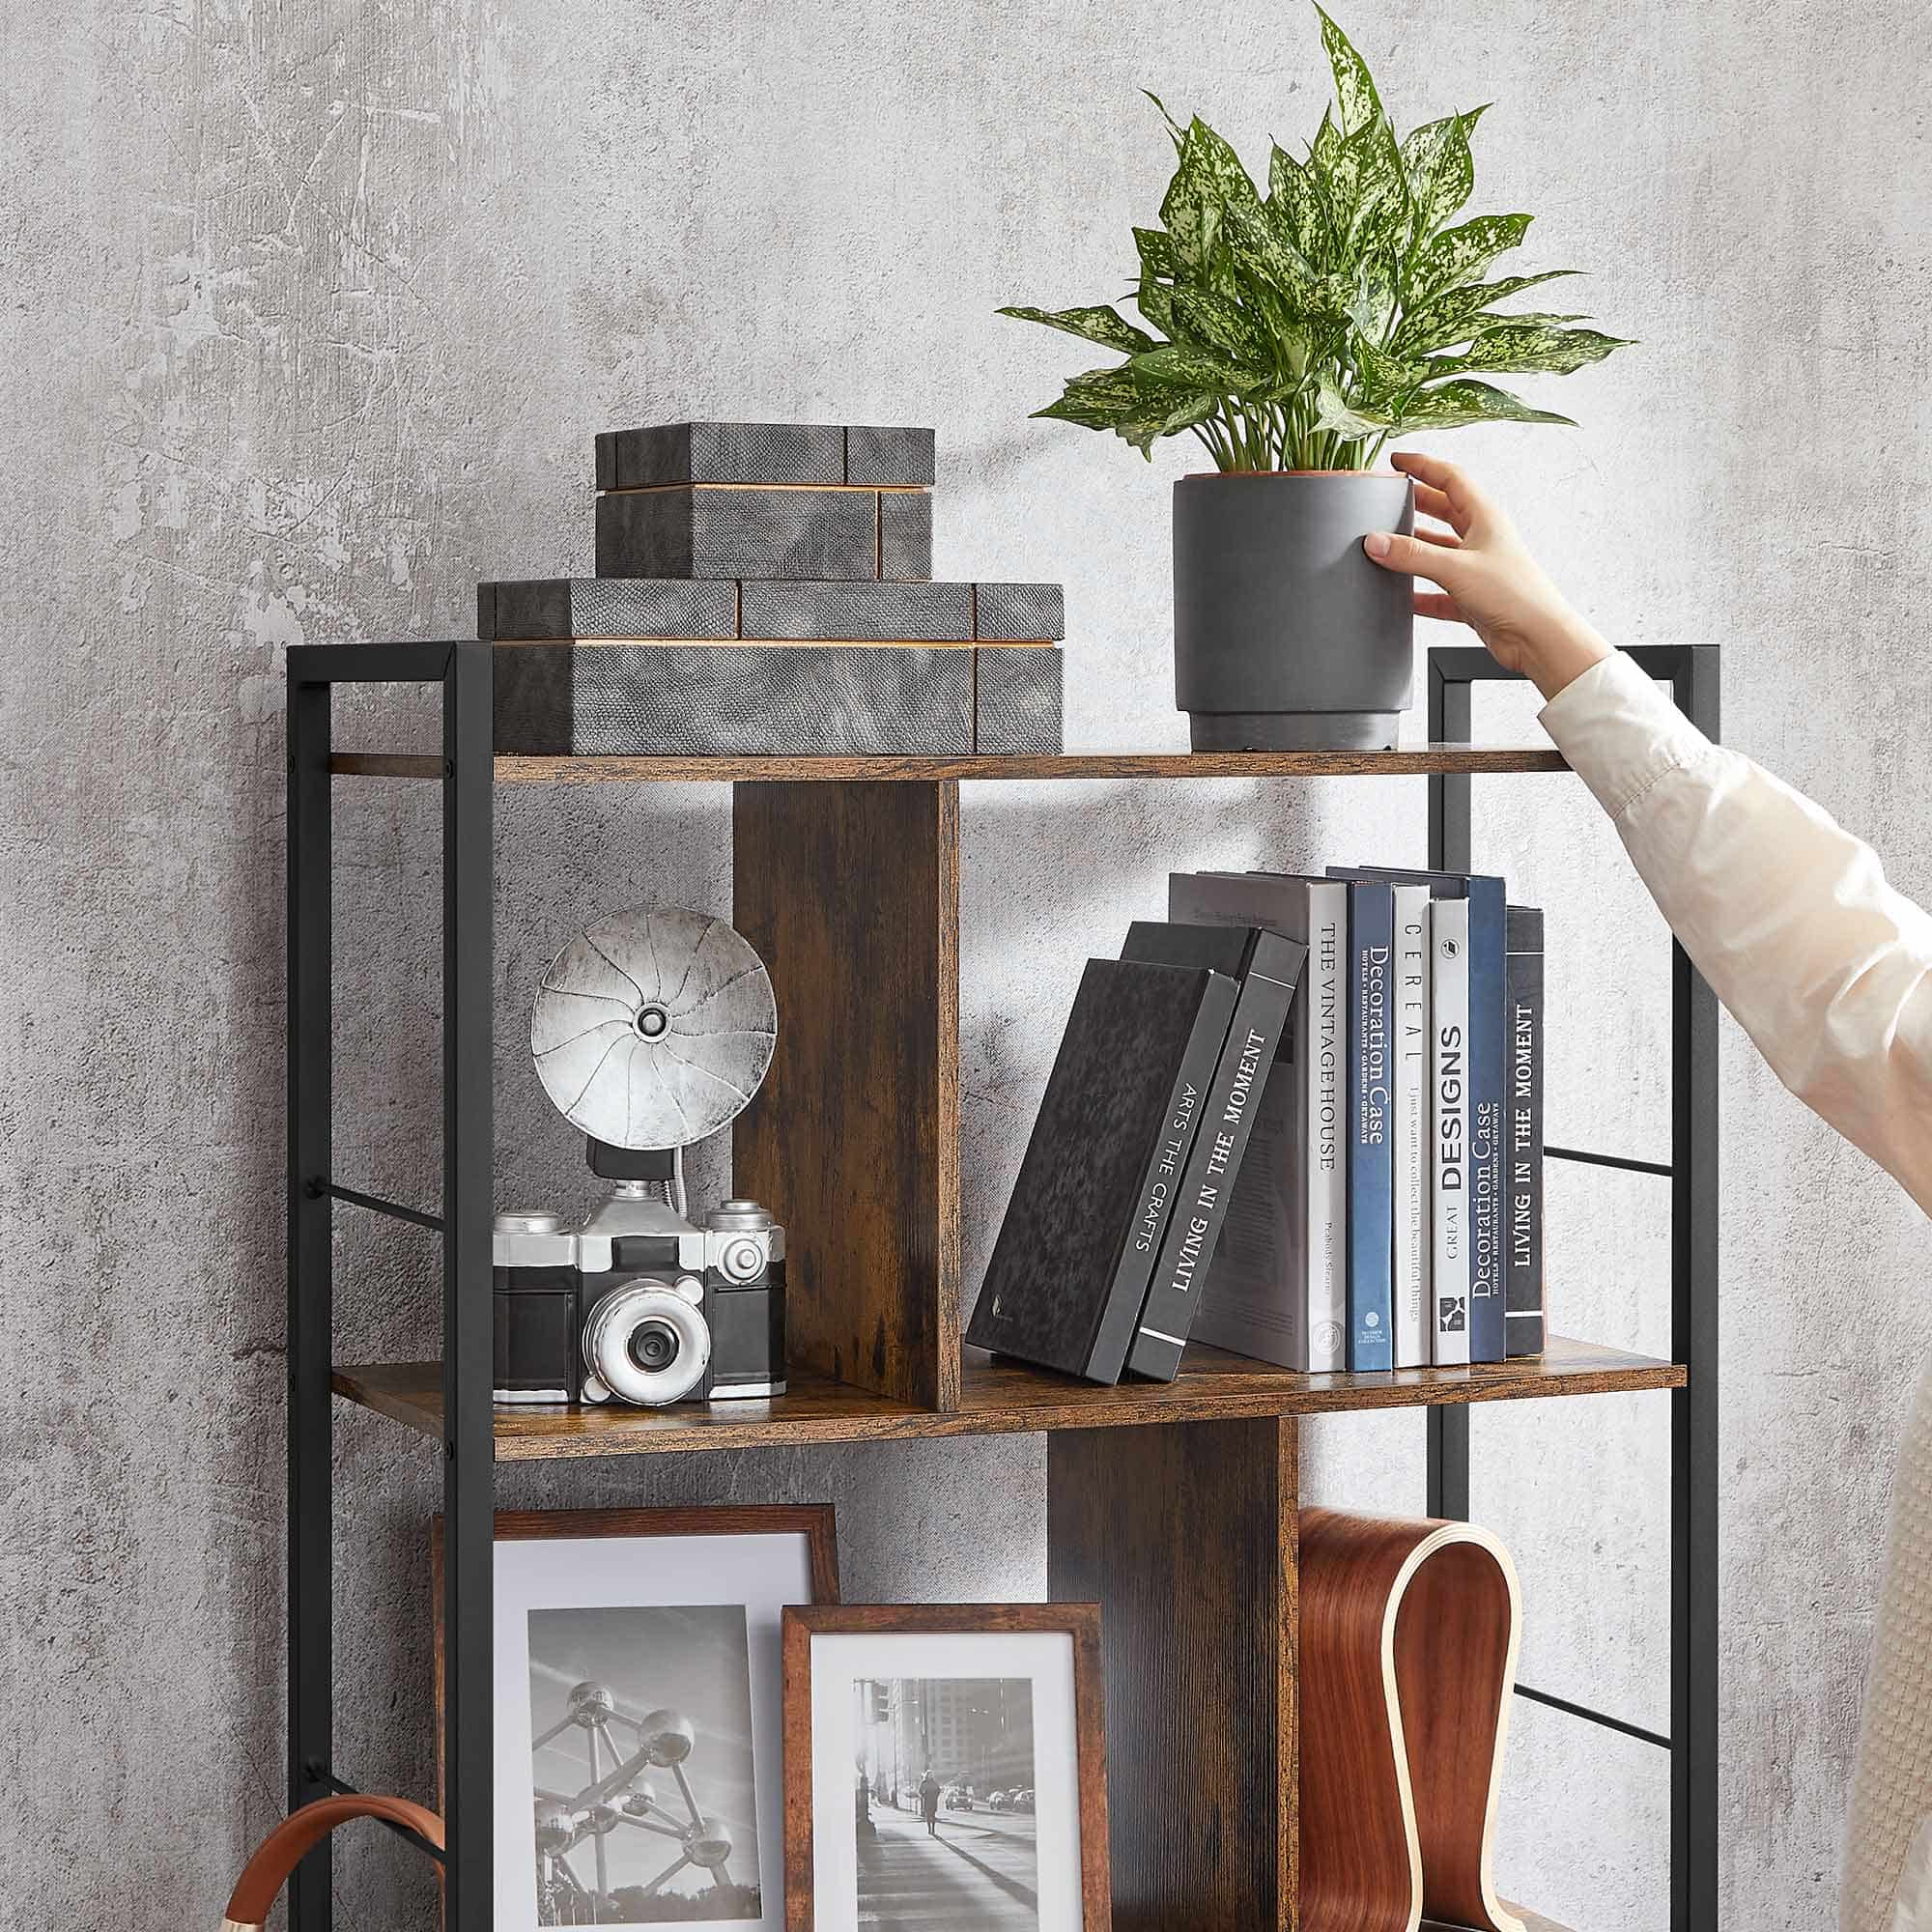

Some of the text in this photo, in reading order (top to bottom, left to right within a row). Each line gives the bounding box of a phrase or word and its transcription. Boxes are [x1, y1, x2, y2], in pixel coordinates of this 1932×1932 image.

[1405, 924, 1422, 1061] CEREAL
[1223, 1028, 1265, 1125] MOMENT
[1320, 923, 1336, 1170] THE VINTAGE HOUSE
[1370, 946, 1389, 1145] Decoration Case
[1135, 1082, 1199, 1252] ARTS THE CRAFTS
[1207, 1131, 1235, 1176] THE
[1409, 1120, 1420, 1149] want
[1409, 1151, 1420, 1163] to
[1440, 1026, 1462, 1260] GREAT DESIGNS
[1514, 1004, 1533, 1267] LIVING IN THE MOMENT
[1197, 1183, 1218, 1209] IN
[1409, 1166, 1421, 1205] collect
[1409, 1208, 1421, 1227] the
[1472, 1102, 1492, 1298] Decoration Case
[1172, 1216, 1208, 1293] LIVING
[1409, 1229, 1422, 1282] beautiful
[1408, 1285, 1422, 1322] things
